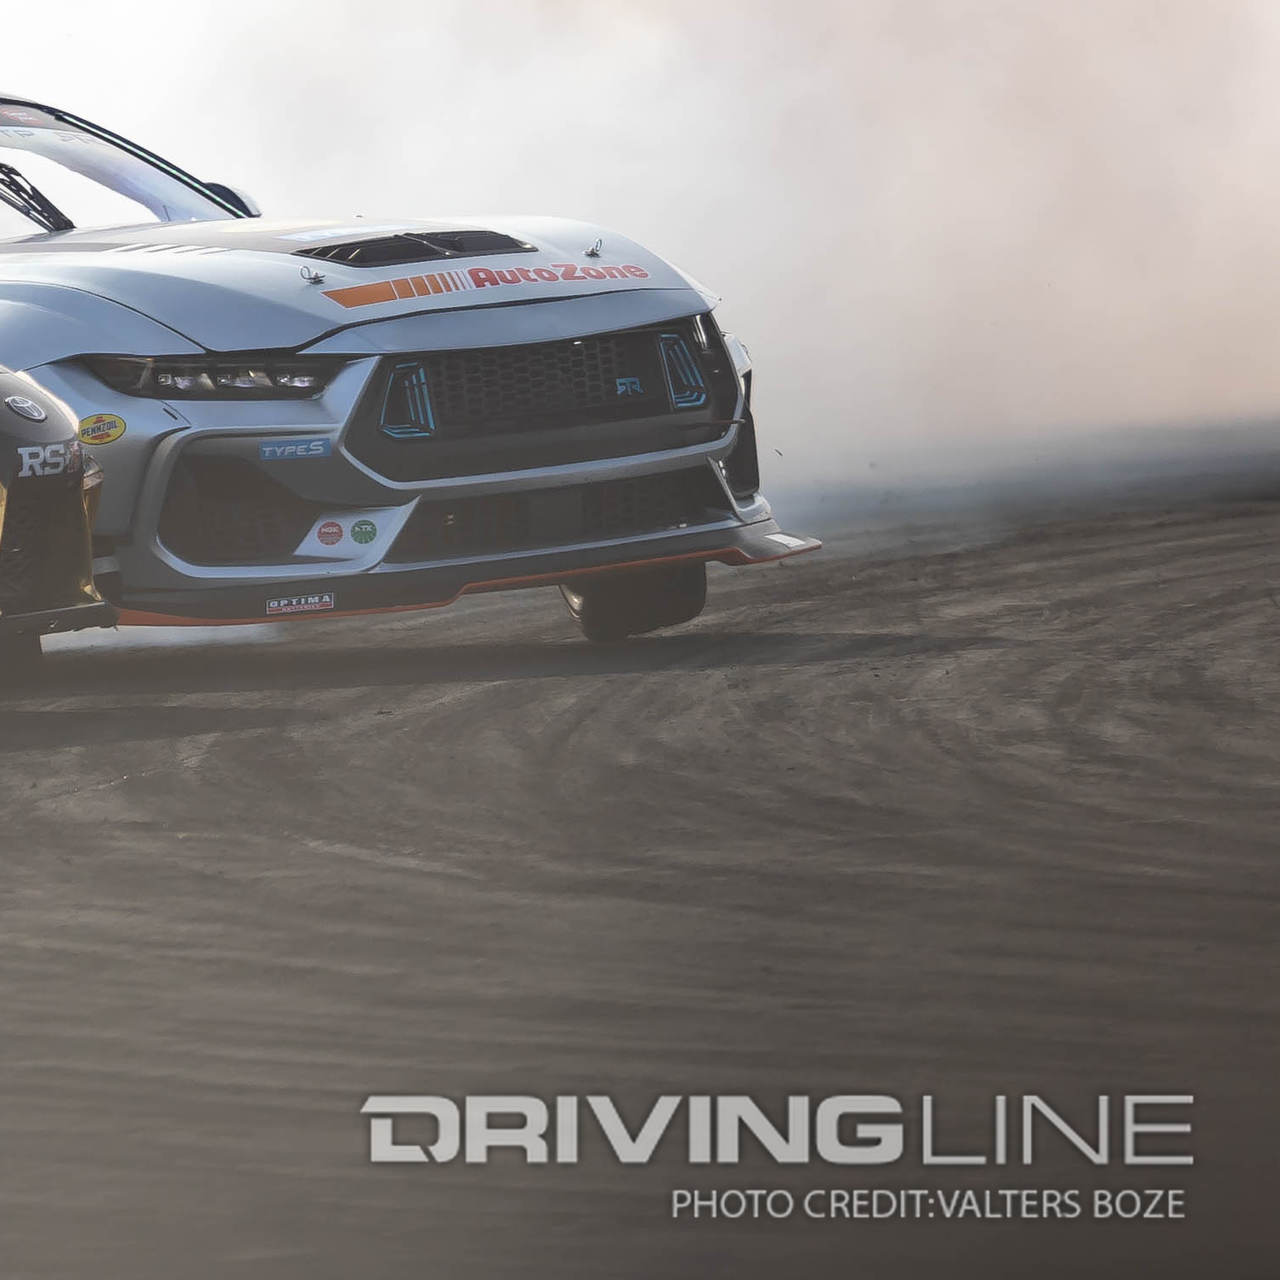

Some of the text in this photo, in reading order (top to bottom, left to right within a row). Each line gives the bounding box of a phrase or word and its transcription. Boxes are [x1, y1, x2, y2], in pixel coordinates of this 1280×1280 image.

[467, 263, 649, 288] AutoZone
[81, 420, 118, 438] PENNZOIL
[269, 595, 331, 609] OPTIMA
